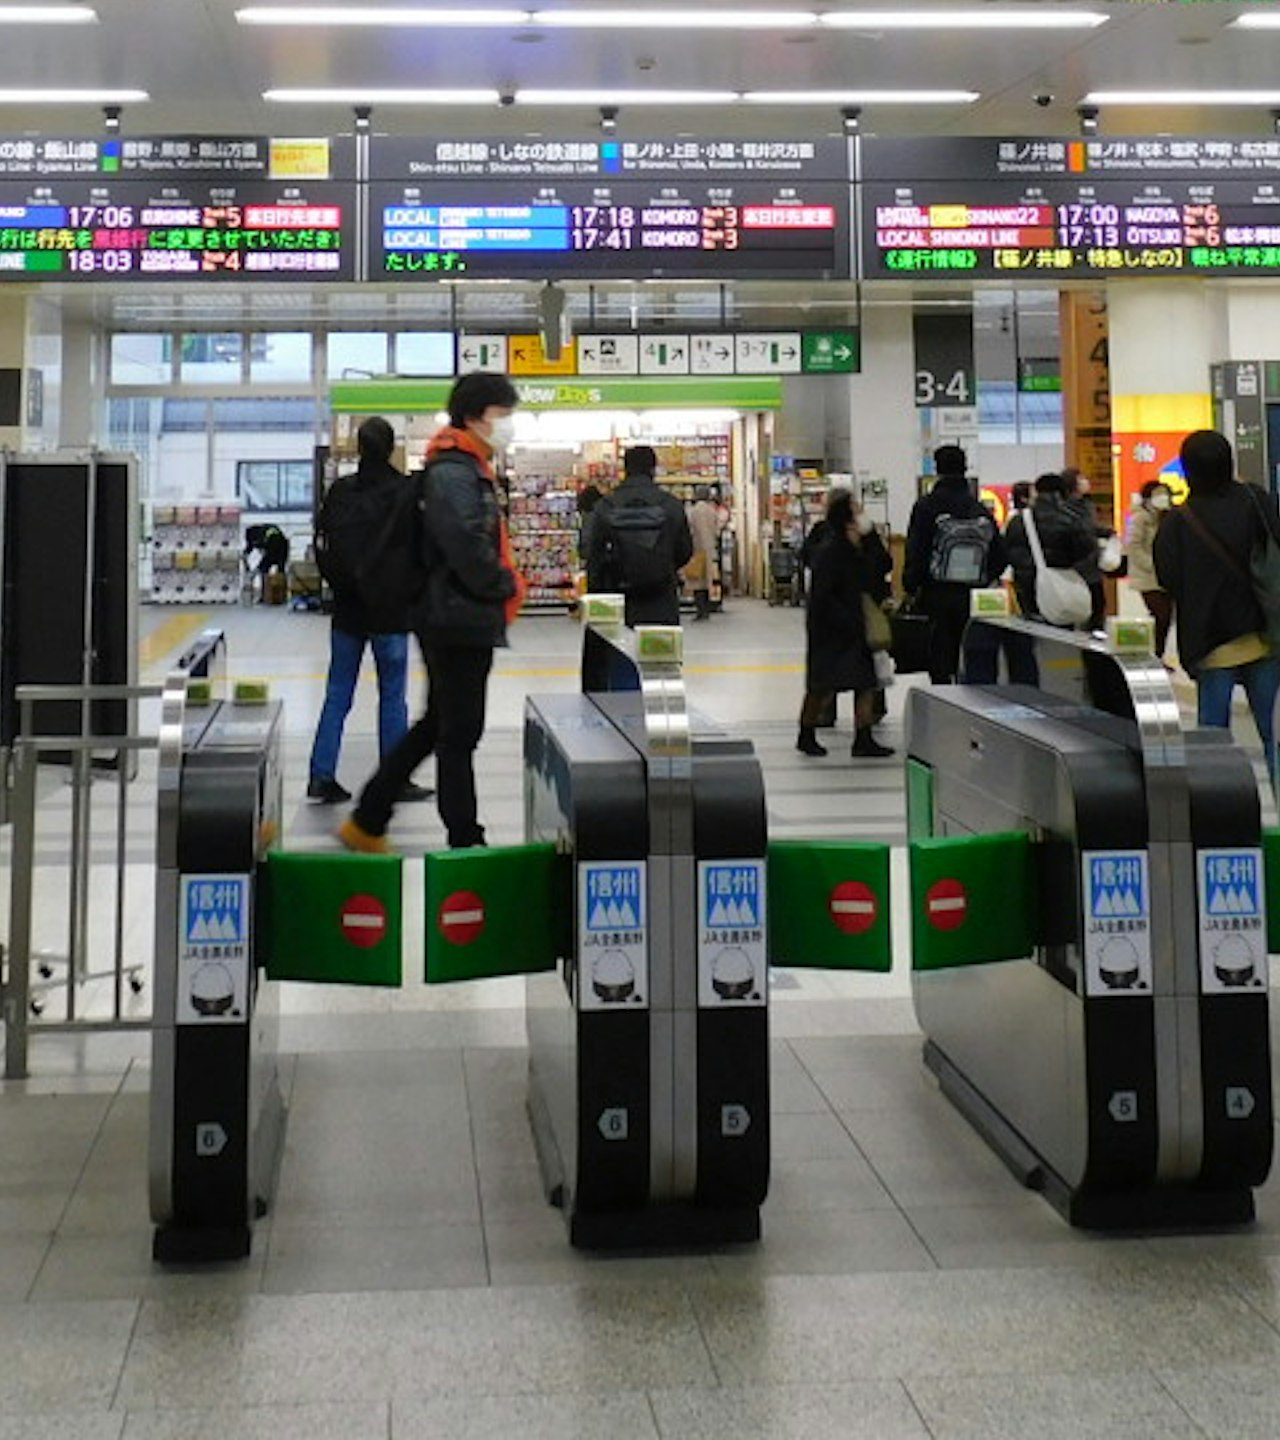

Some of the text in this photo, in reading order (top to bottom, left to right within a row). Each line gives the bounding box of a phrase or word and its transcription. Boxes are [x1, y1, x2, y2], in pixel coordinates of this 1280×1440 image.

[68, 206, 133, 228] 17:06
[227, 207, 242, 228] 5
[385, 207, 436, 227] LOCAL
[571, 207, 636, 228] 17:18
[641, 208, 700, 226] KOMORO
[724, 207, 738, 228] 3
[1058, 205, 1119, 226] 17:00
[1124, 207, 1181, 224] NAGOYA
[1204, 205, 1220, 226] 6
[385, 229, 436, 248] LOCAL
[571, 228, 632, 250] 17:41
[641, 229, 700, 248] KOMORO
[724, 228, 738, 250] 3
[877, 228, 928, 247] LOCAL
[1059, 227, 1119, 247] 17:13
[1205, 226, 1220, 247] 6
[68, 250, 133, 271] 18:03
[224, 251, 241, 271] 4
[385, 252, 467, 271] たします。
[1093, 860, 1140, 886] 信州
[1208, 857, 1255, 884] 信州
[589, 870, 637, 897] 信州
[708, 868, 756, 895] 信州
[191, 883, 240, 910] 信州
[1118, 1097, 1131, 1115] 5
[1230, 1094, 1244, 1110] 4
[608, 1114, 620, 1131] 6
[727, 1111, 740, 1129] 5
